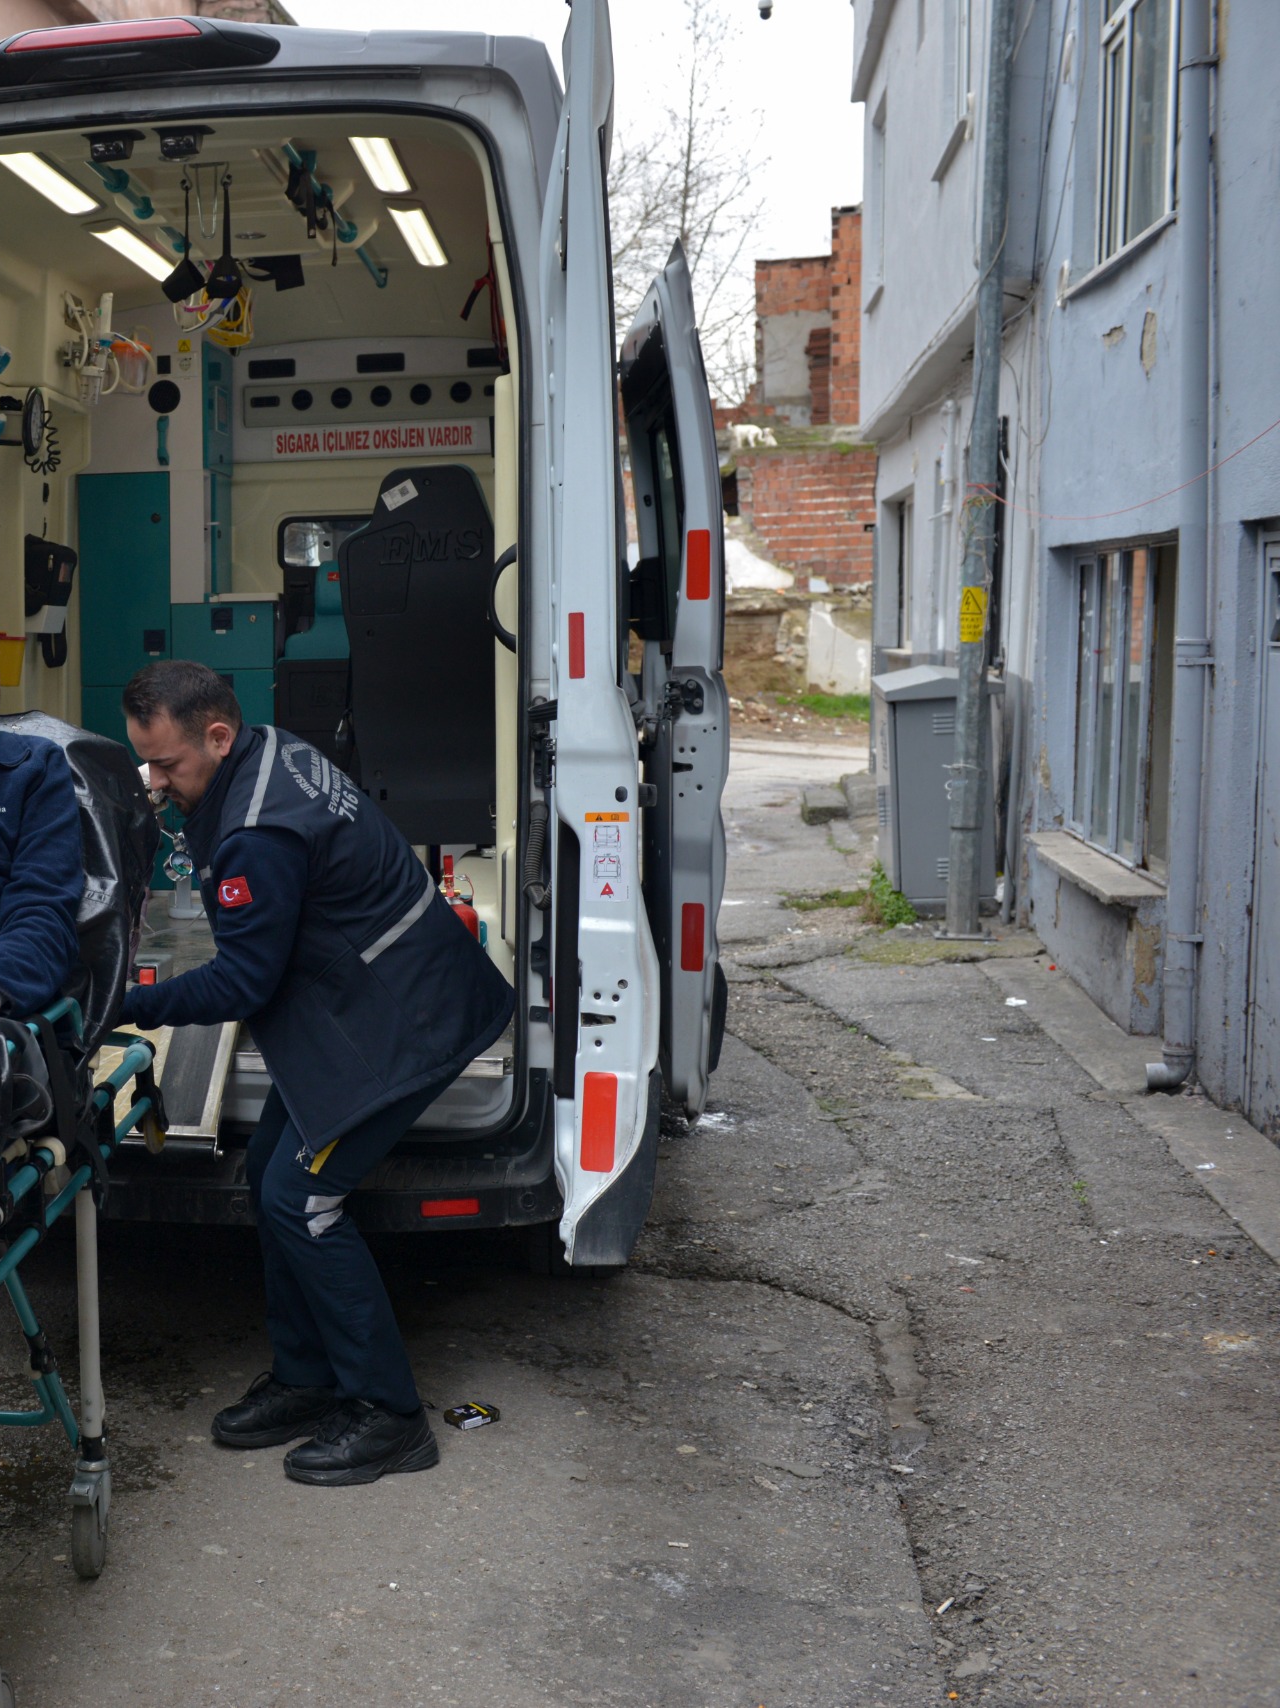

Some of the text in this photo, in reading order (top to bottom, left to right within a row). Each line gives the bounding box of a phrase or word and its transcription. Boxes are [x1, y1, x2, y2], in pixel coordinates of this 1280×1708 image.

[276, 425, 473, 455] SİGARA İÇİLMEZ OKSİJEN VARDIR
[379, 528, 484, 566] EMS
[293, 773, 320, 800] BURSA
[327, 789, 341, 814] EVDE
[338, 790, 359, 823] 716
